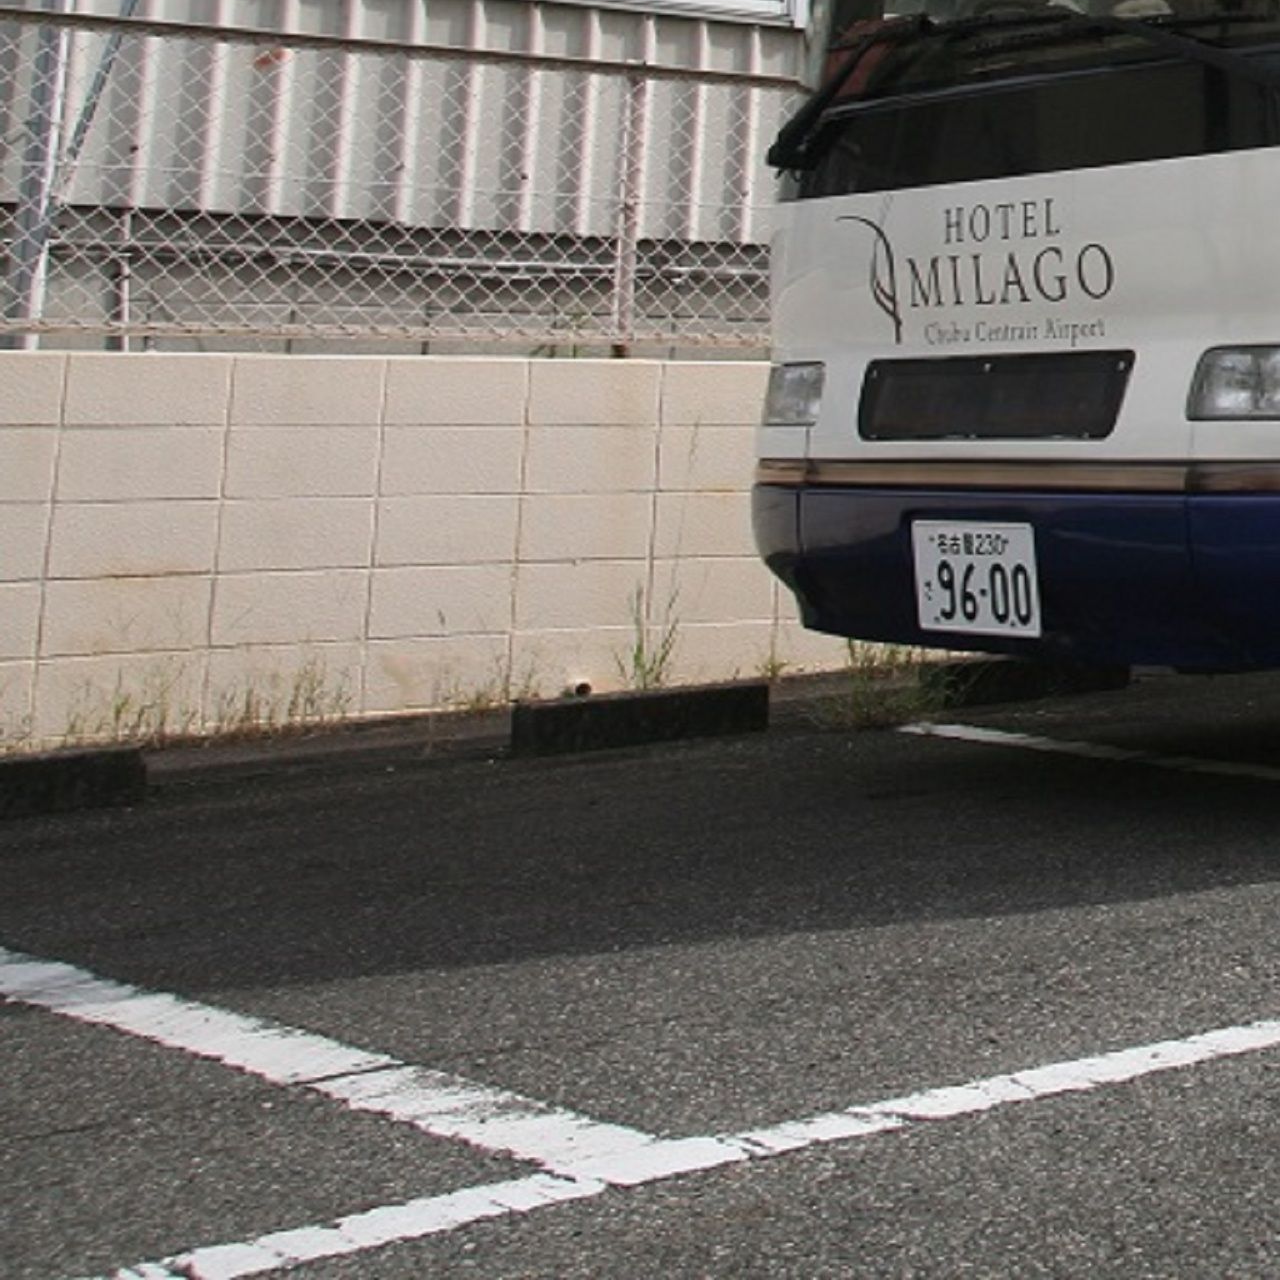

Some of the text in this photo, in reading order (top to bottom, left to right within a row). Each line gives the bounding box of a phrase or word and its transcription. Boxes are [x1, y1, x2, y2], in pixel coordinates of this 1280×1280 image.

[943, 197, 1061, 245] HOTEL
[905, 242, 1115, 309] MILAGO
[1043, 317, 1106, 349] Airport
